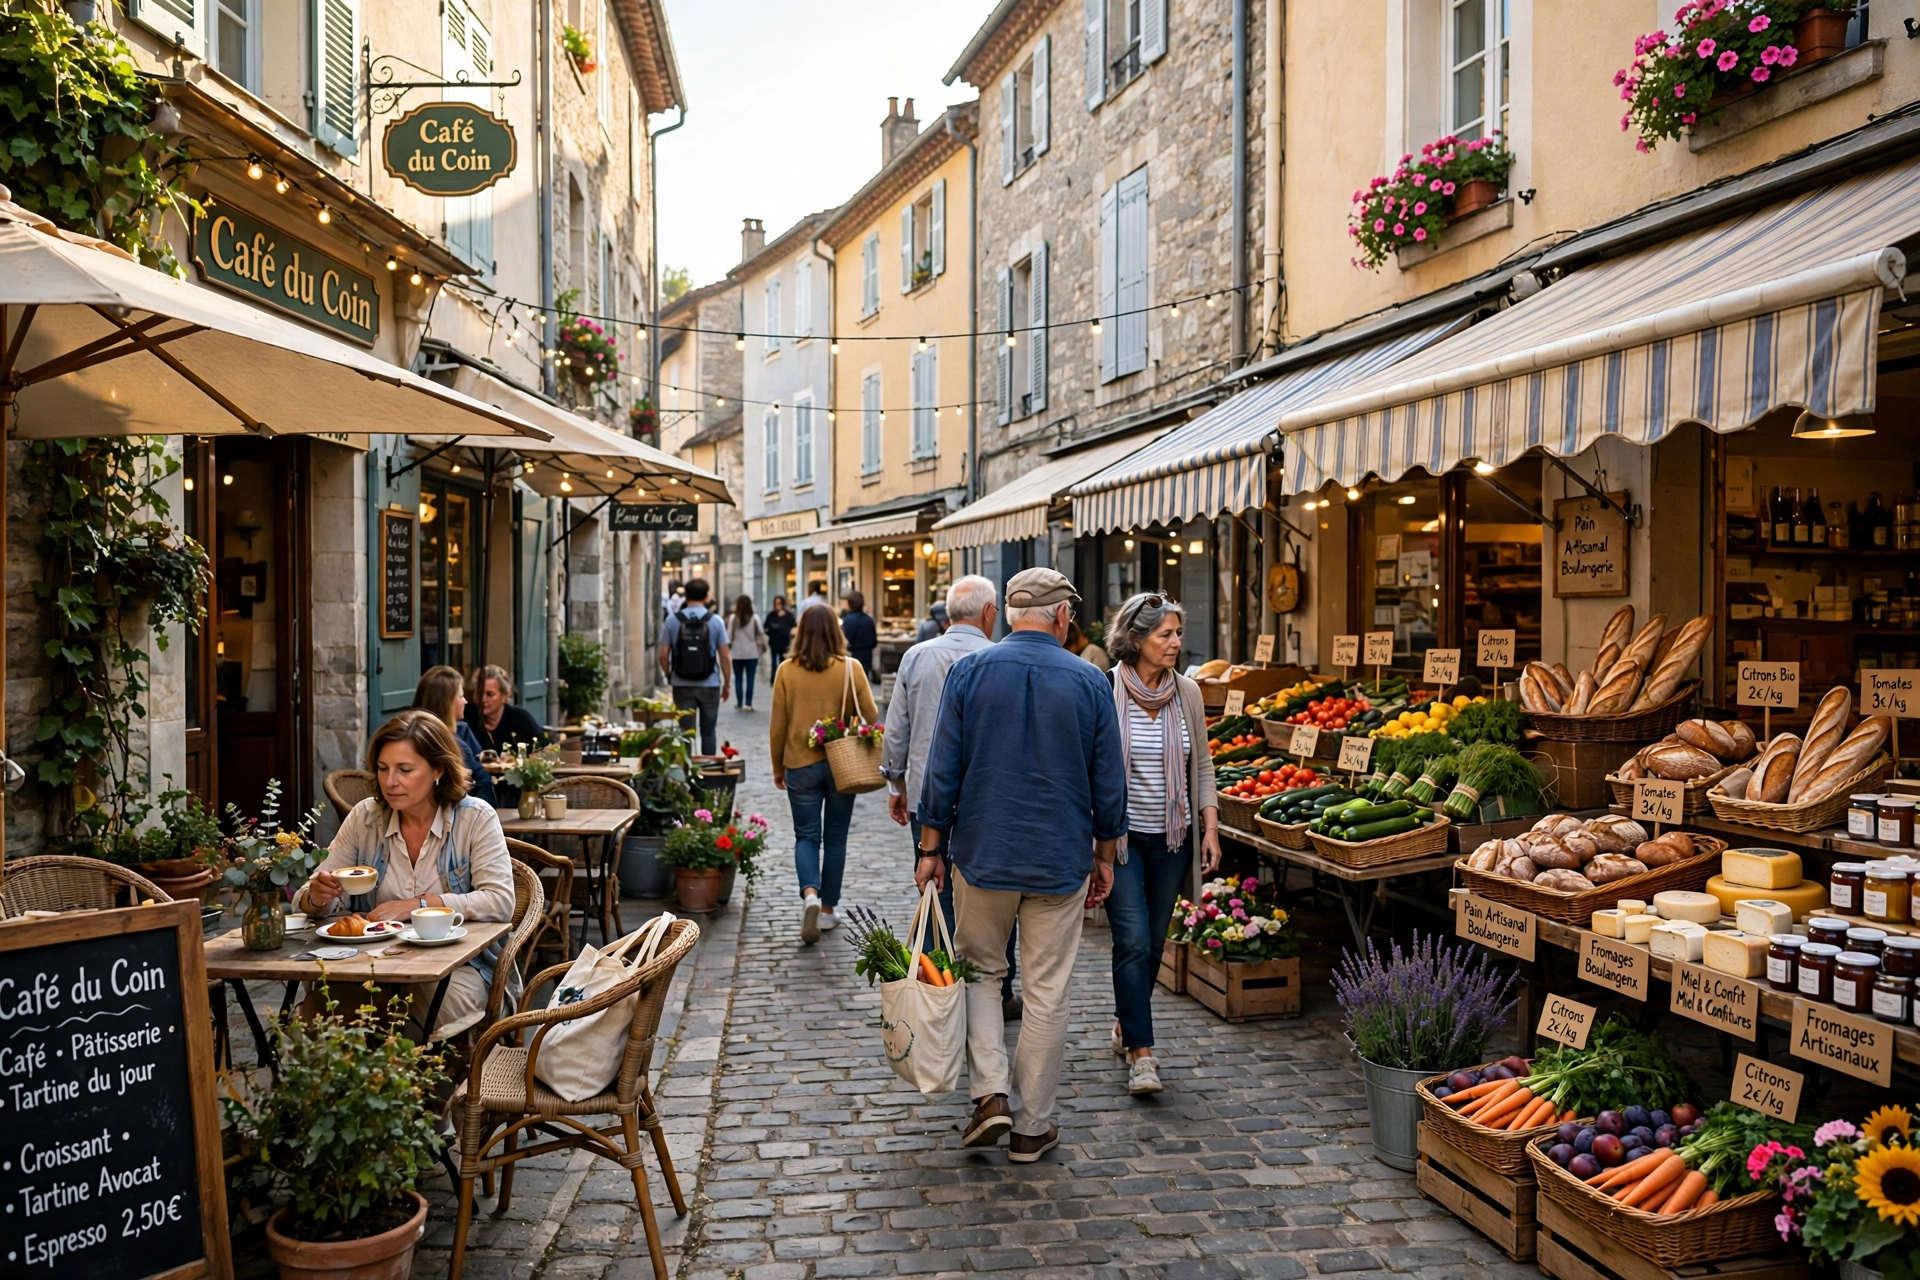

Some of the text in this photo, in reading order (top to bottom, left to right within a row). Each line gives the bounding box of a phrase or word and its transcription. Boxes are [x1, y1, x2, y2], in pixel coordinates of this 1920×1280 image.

[420, 118, 475, 143] Café
[408, 148, 492, 171] du Coin
[210, 215, 371, 330] Café du Coin
[1575, 516, 1595, 532] Pain
[1742, 667, 1796, 682] Citrons Bio
[1870, 674, 1912, 690] Tomates
[1748, 685, 1783, 704] 2€/kg
[1872, 692, 1907, 713] 3€/kg
[1639, 783, 1676, 799] Tomates
[1641, 799, 1672, 820] 3€/kg
[1464, 900, 1528, 933] Pain Artisanal
[1591, 939, 1634, 969] Fromages
[0, 957, 165, 1020] Café du Coin
[1680, 969, 1746, 1005] Miel & Confit
[1550, 1000, 1585, 1023] Citrons
[1676, 990, 1695, 1011] Miel
[1705, 999, 1752, 1029] Confitures
[1546, 1017, 1577, 1043] 2€/kg
[1807, 1007, 1875, 1048] Fromages
[0, 1022, 162, 1078] Café Pâtisserie
[1800, 1028, 1879, 1074] Artisanaux
[9, 1060, 156, 1112] Tartine du jour
[1745, 1062, 1791, 1092] Citrons
[1743, 1082, 1784, 1115] 2€/kg
[20, 1128, 113, 1174] Croissant
[19, 1156, 162, 1217] Tartine Avocat
[25, 1194, 182, 1268] Espresso 2,50€
